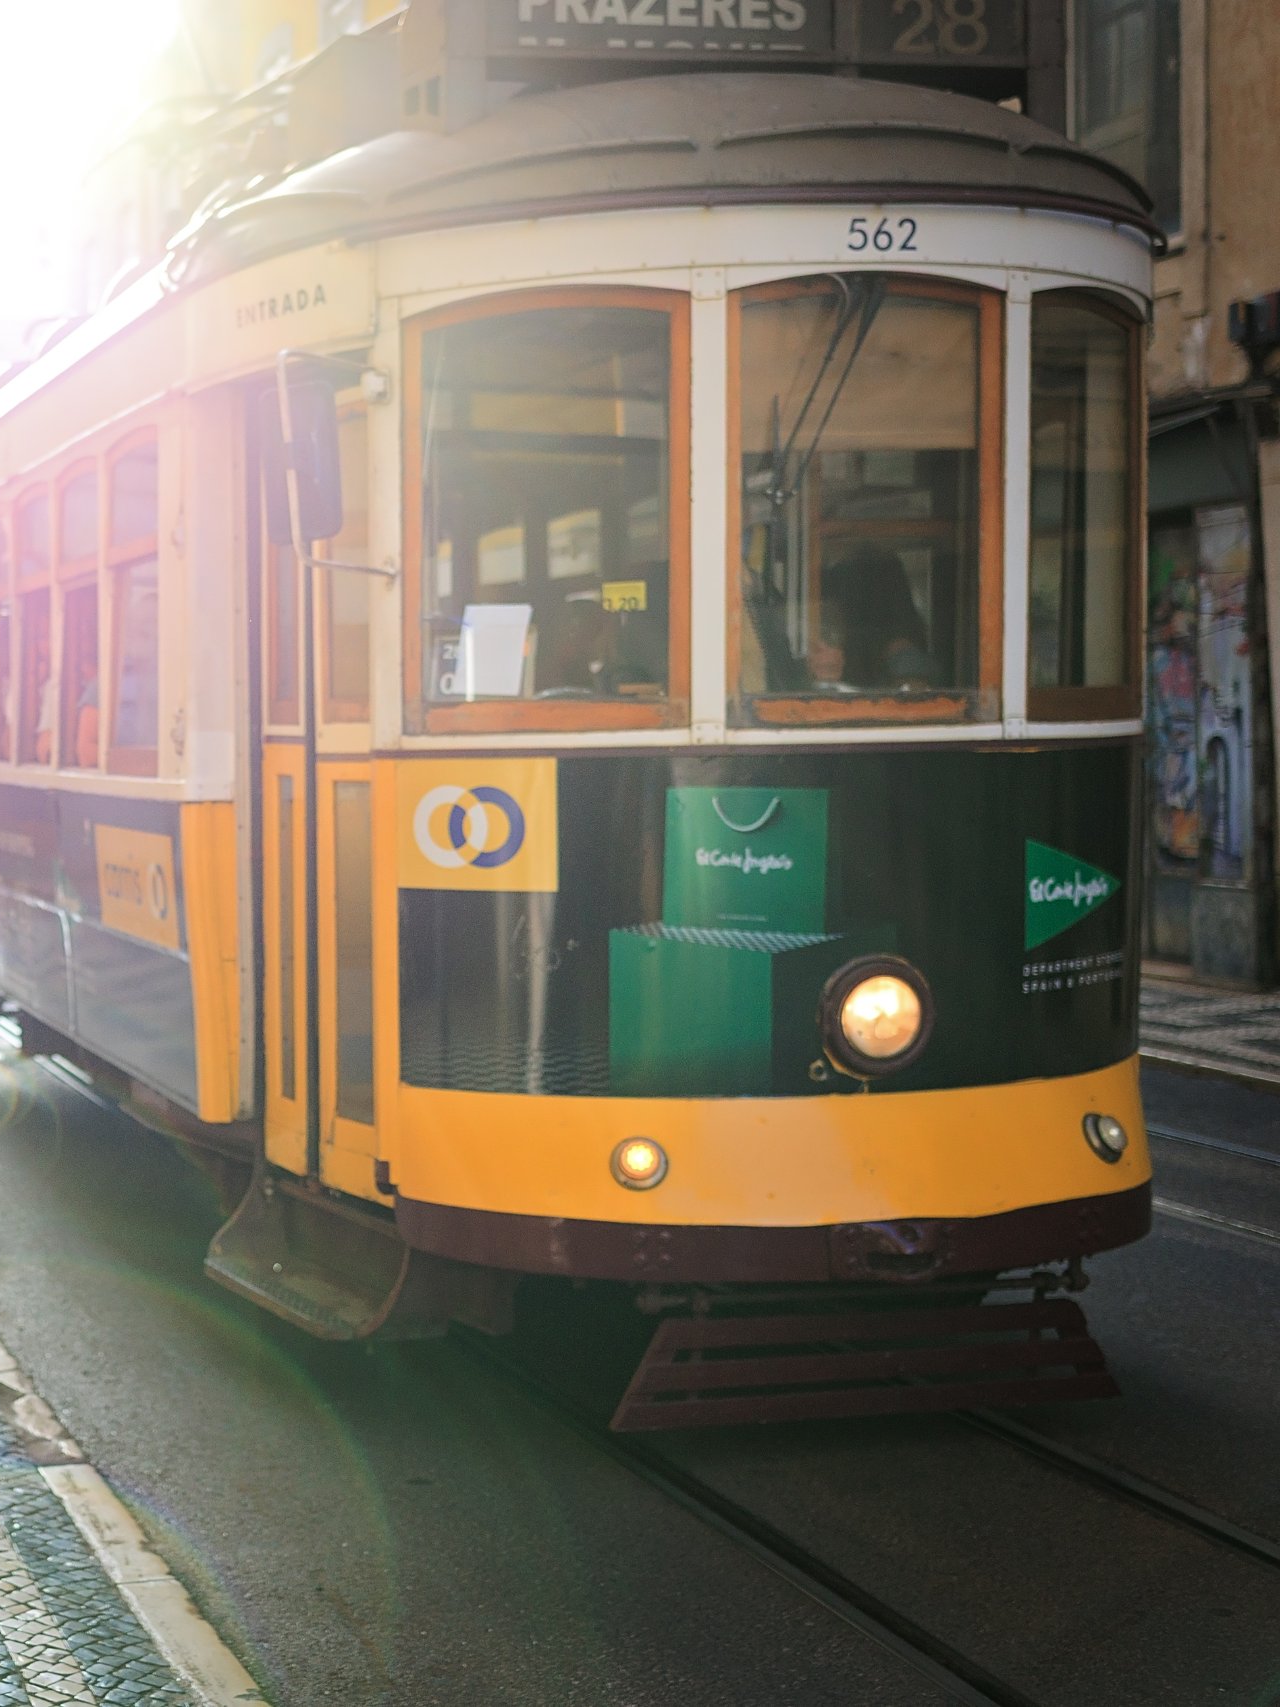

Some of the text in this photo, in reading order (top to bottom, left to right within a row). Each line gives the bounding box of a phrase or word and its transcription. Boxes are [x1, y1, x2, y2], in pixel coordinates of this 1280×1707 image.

[519, 0, 807, 31] PRAZERES
[894, 0, 989, 54] 28
[847, 217, 918, 251] 562
[236, 283, 326, 329] ENTRADA
[1022, 979, 1062, 994] SPAIN
